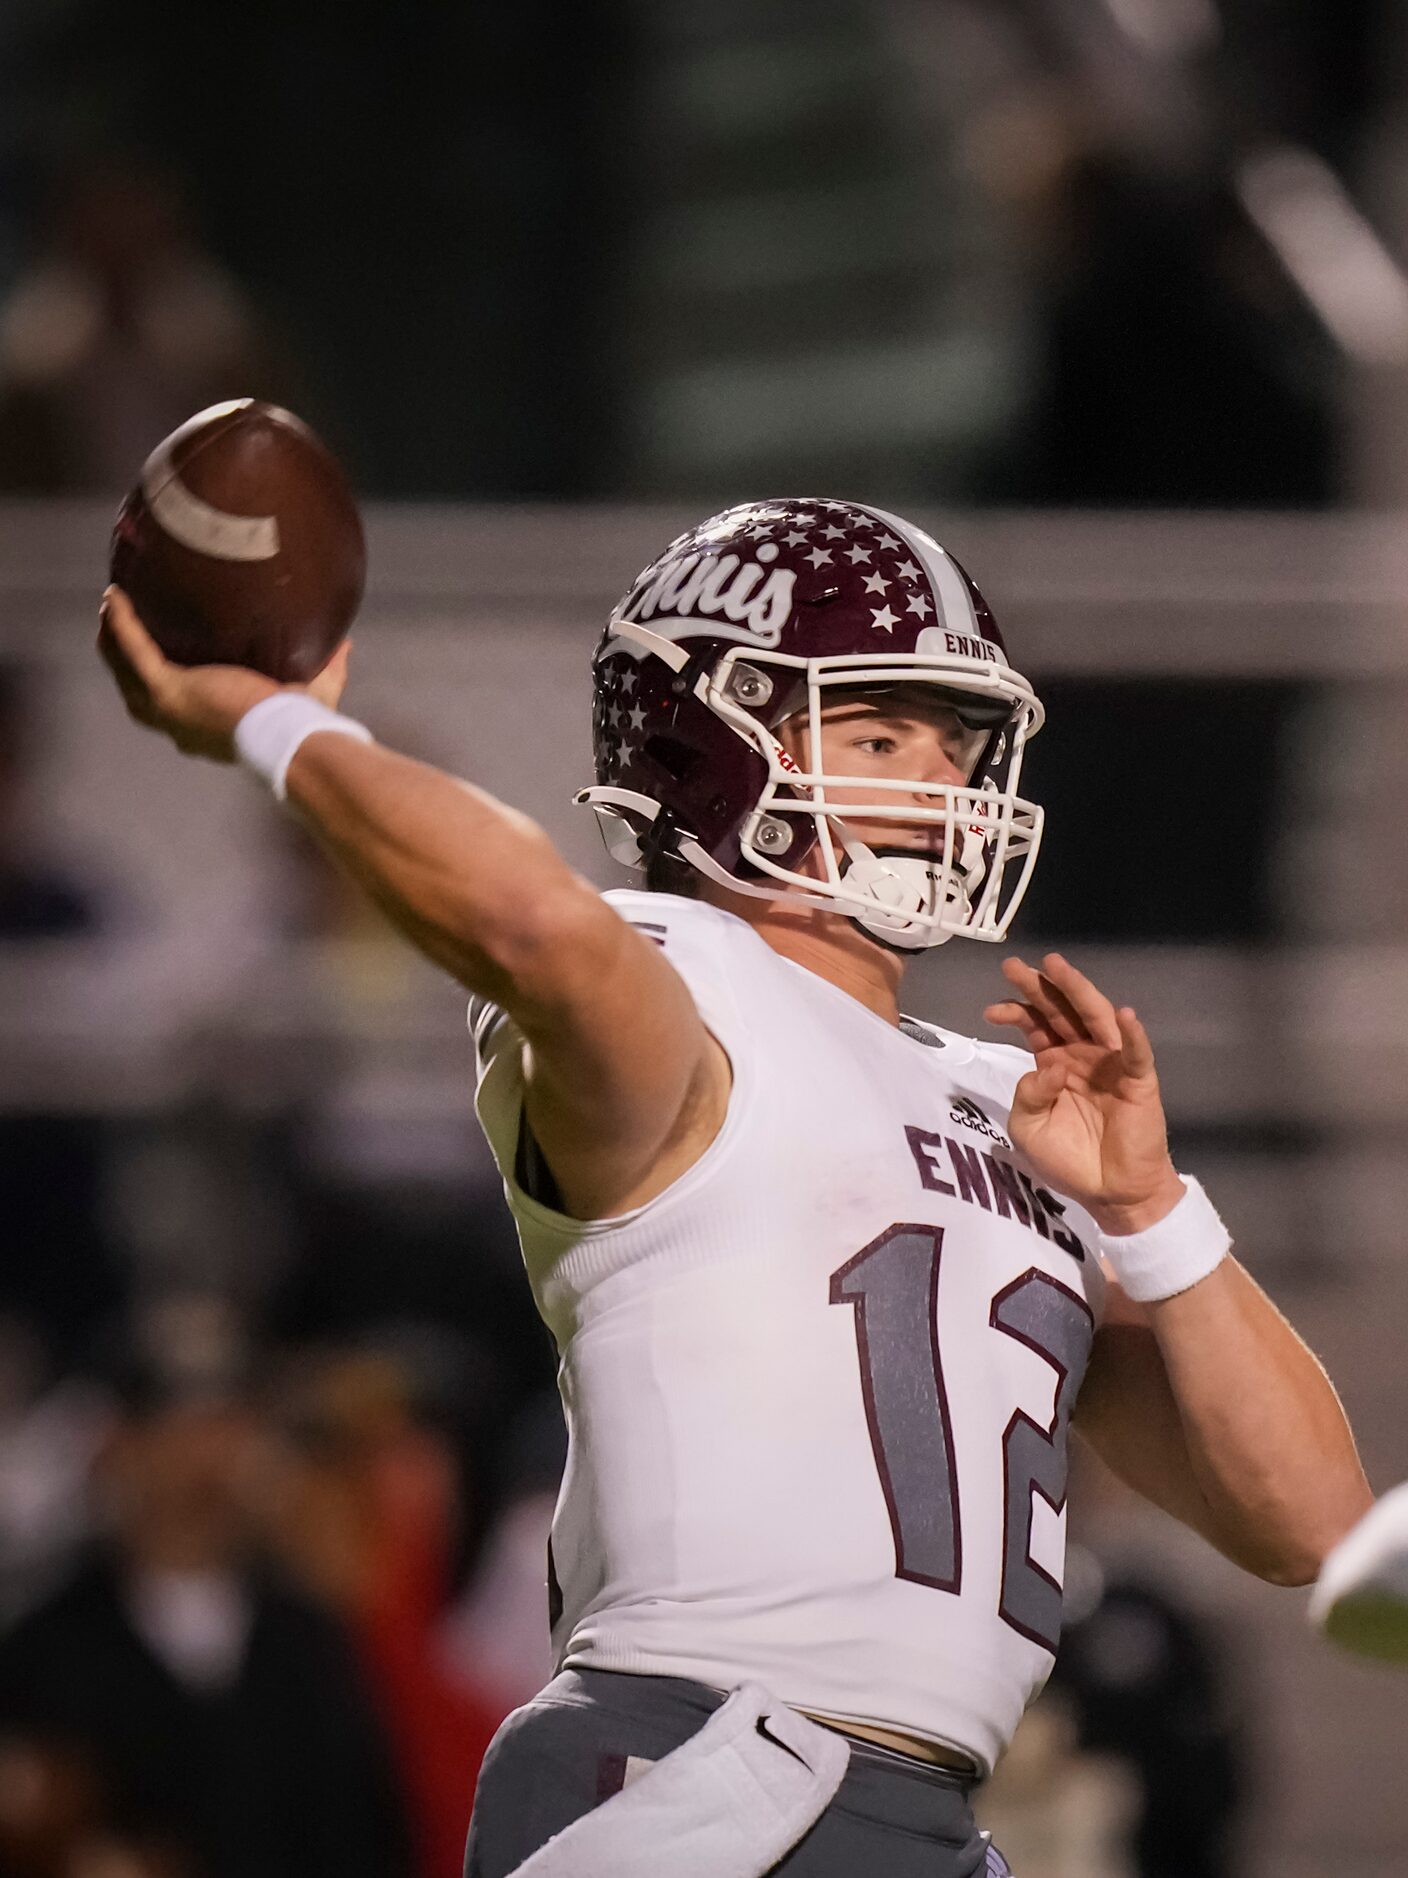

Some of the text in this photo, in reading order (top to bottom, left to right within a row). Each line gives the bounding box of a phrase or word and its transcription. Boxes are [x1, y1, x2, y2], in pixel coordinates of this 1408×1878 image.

[944, 633, 996, 662] ENNIS
[949, 1111, 1011, 1150] adidas
[904, 1124, 1086, 1264] ENNIS
[829, 1222, 1095, 1658] 12
